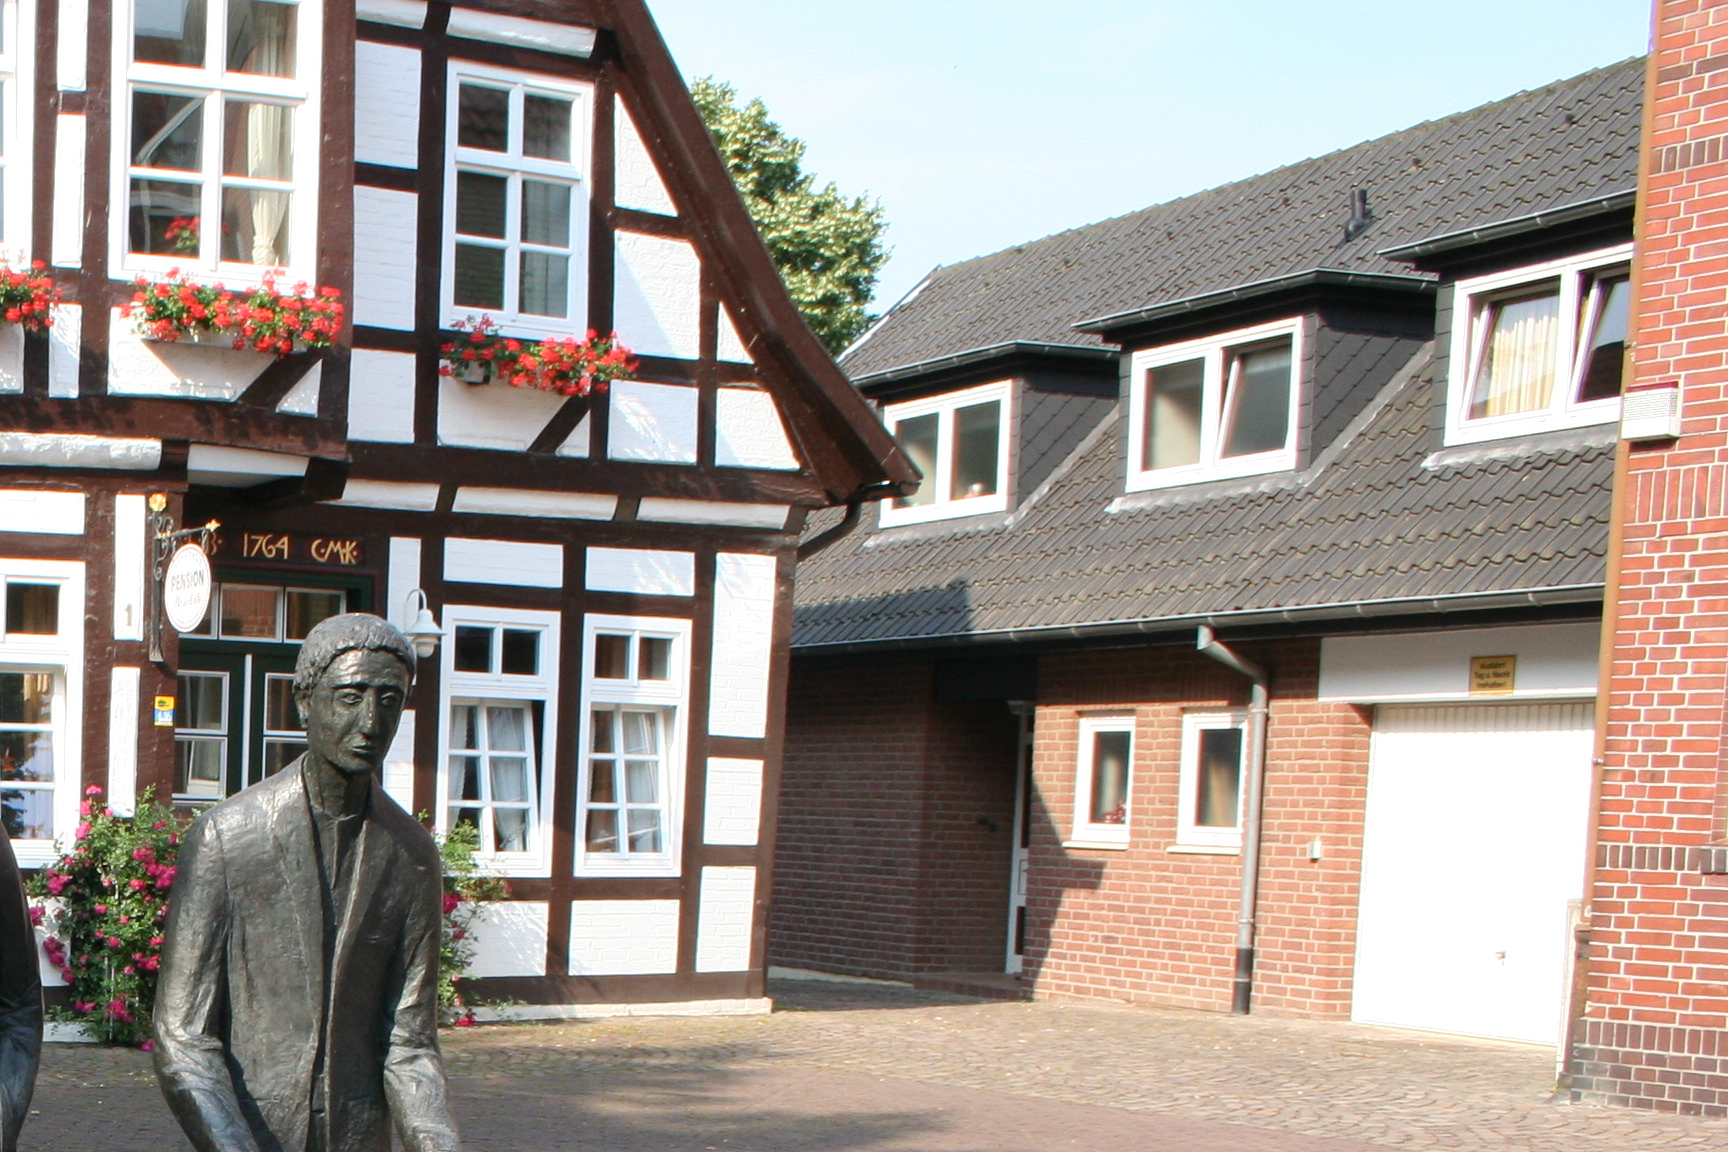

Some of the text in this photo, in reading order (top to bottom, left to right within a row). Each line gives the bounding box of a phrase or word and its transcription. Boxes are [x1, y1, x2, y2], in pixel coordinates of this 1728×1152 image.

[243, 532, 290, 560] 1764
[171, 569, 205, 592] PENSION
[124, 602, 134, 628] 1
